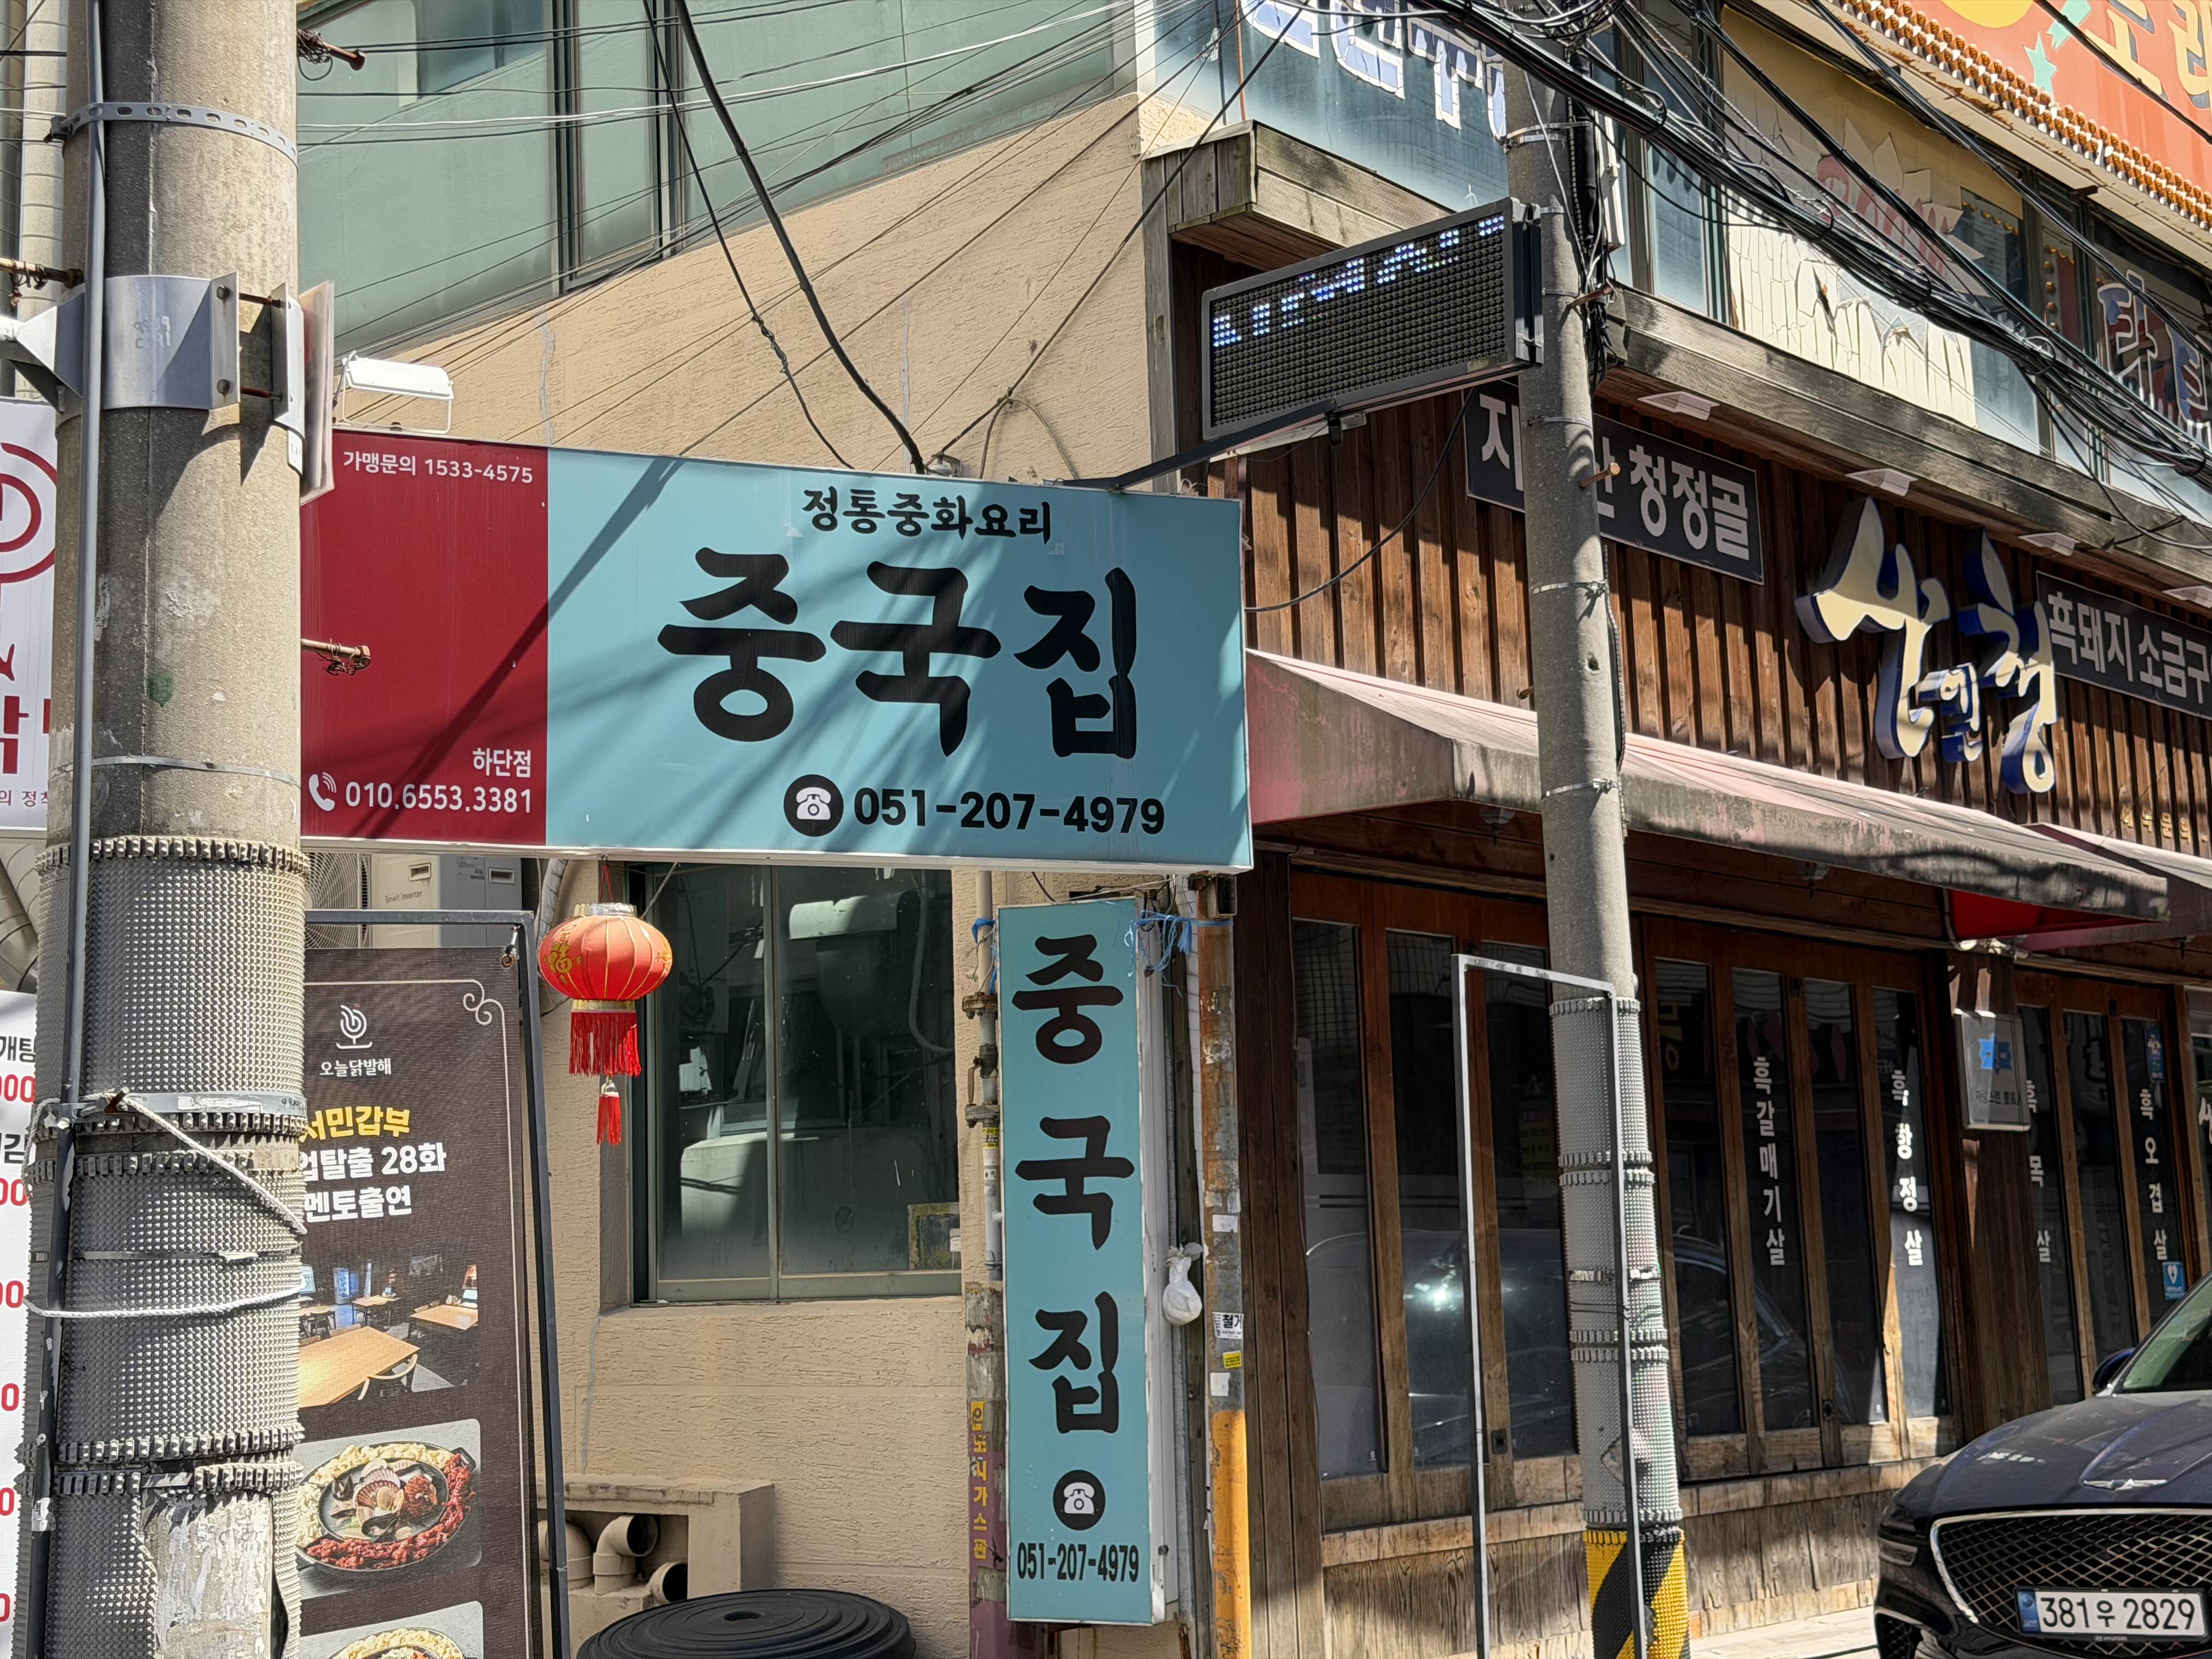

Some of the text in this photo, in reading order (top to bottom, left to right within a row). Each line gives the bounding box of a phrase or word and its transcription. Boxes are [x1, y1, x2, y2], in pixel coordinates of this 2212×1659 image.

[343, 450, 533, 484] 가맹문의 1533-4575
[802, 485, 1052, 545] 정통중화요리
[1629, 444, 1750, 561] 청정골
[657, 546, 1137, 760] 중국집
[2048, 591, 2212, 704] 흑돼지 소금구
[472, 747, 532, 778] 하단점
[346, 781, 531, 814] 010.6553.3381
[854, 787, 1166, 836] 051-207-4979
[385, 890, 423, 903] Smart Inverter
[319, 1058, 392, 1077] 오늘닭발해
[298, 1106, 410, 1143] 서민갑부
[381, 1143, 447, 1175] 28화
[1753, 1056, 1785, 1266] 흑갈매기살
[2140, 1088, 2168, 1260] 흑오겹살
[1012, 934, 1135, 1434] 중국집
[304, 1185, 412, 1223] 멘토출연
[1018, 1542, 1139, 1583] 051-207-4979
[2040, 1597, 2195, 1629] 381우 2829
